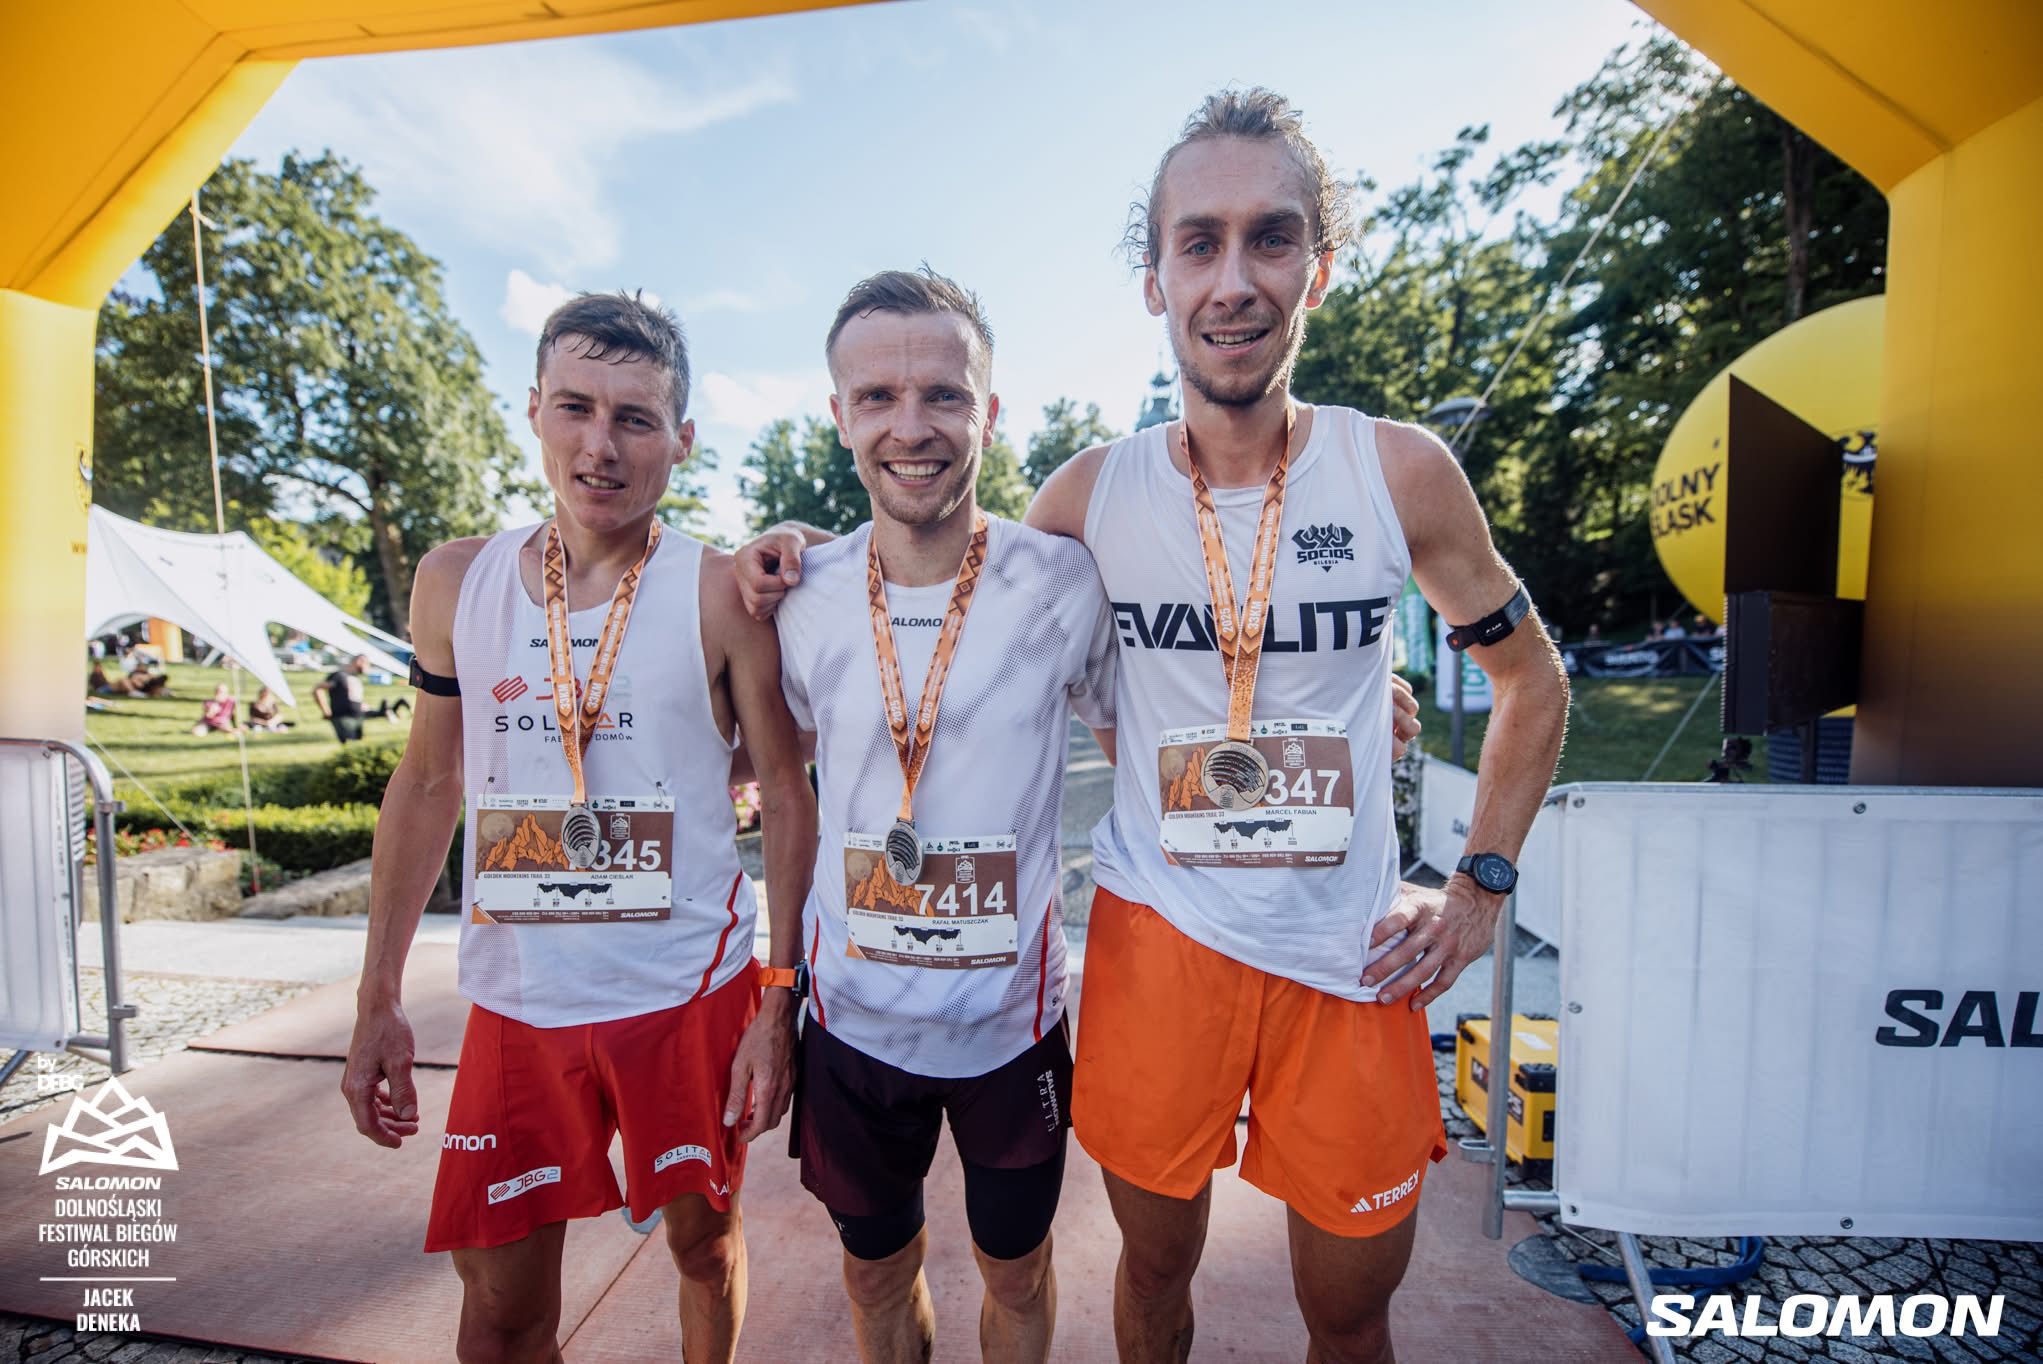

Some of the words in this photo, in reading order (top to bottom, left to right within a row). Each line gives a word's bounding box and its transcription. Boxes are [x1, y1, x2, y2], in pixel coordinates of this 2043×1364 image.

[1296, 548, 1354, 564] SOCIOS
[888, 617, 942, 627] ALOMO
[1112, 596, 1388, 652] EVALITE
[1220, 608, 1234, 633] 2025
[1247, 601, 1263, 630] 33KM
[530, 638, 600, 648] SAMON
[557, 684, 570, 710] 33KM
[586, 683, 603, 708] 33KM
[495, 712, 633, 732] SOLAR
[890, 700, 903, 723] 2025
[920, 702, 933, 724] 2025
[1265, 768, 1340, 805] 347
[570, 840, 661, 870] 345
[914, 881, 1008, 916] 7414
[952, 918, 988, 926] MATUSZCZAK
[970, 956, 1006, 964] SALOMON
[1875, 989, 2043, 1048] SAL
[1036, 1074, 1056, 1132] ULTRA
[1045, 1070, 1060, 1126] SALOMON
[442, 1132, 496, 1151] omon
[514, 1168, 559, 1192] JBG2
[1372, 1169, 1421, 1210] TERREX
